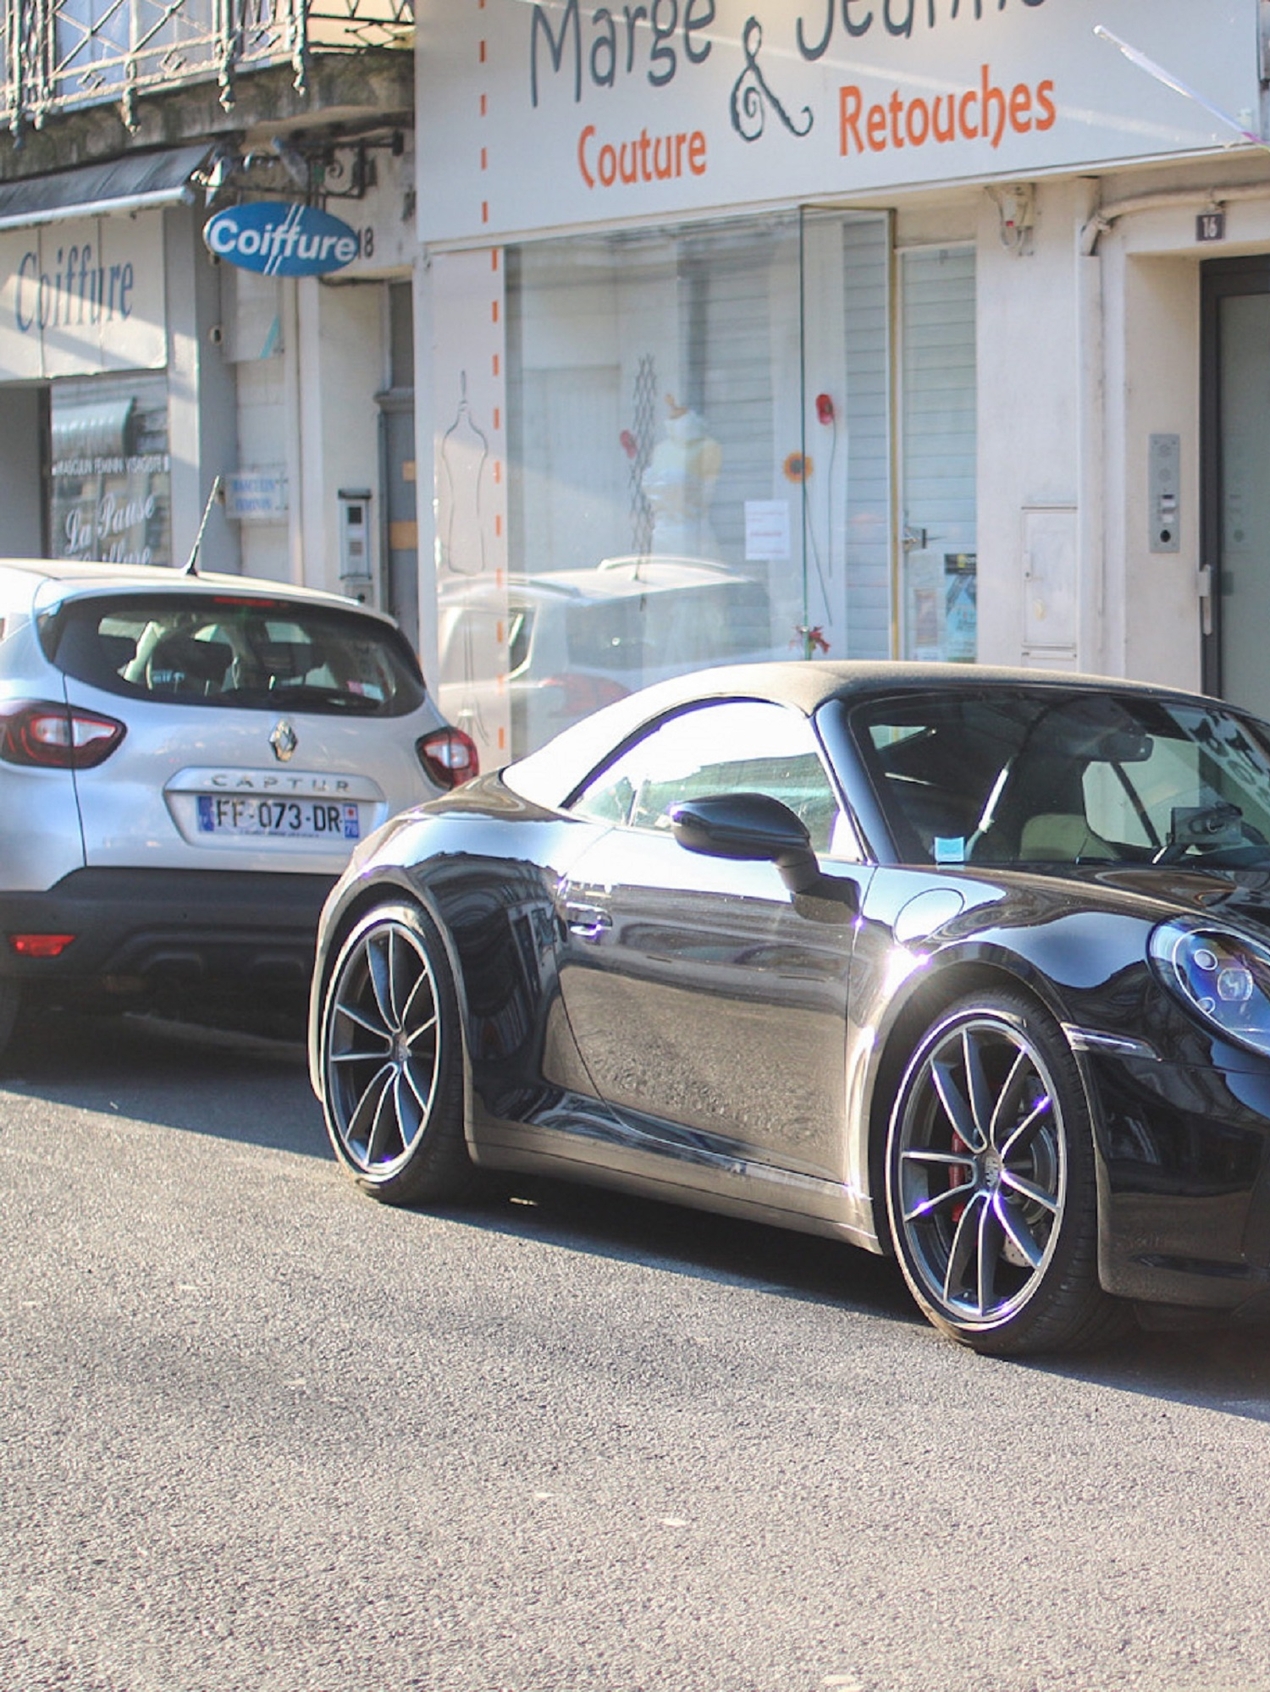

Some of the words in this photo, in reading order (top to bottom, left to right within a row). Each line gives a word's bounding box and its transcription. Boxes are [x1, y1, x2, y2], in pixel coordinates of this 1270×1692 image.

[531, 0, 715, 108] Marge
[731, 16, 814, 142] &
[577, 124, 707, 190] Couture
[839, 63, 1057, 157] Retouches
[210, 219, 357, 262] Coiffure
[1202, 216, 1218, 238] 16
[15, 244, 134, 333] Coiffure
[211, 774, 350, 793] CAPTUR
[216, 799, 342, 833] FF-073-DR
